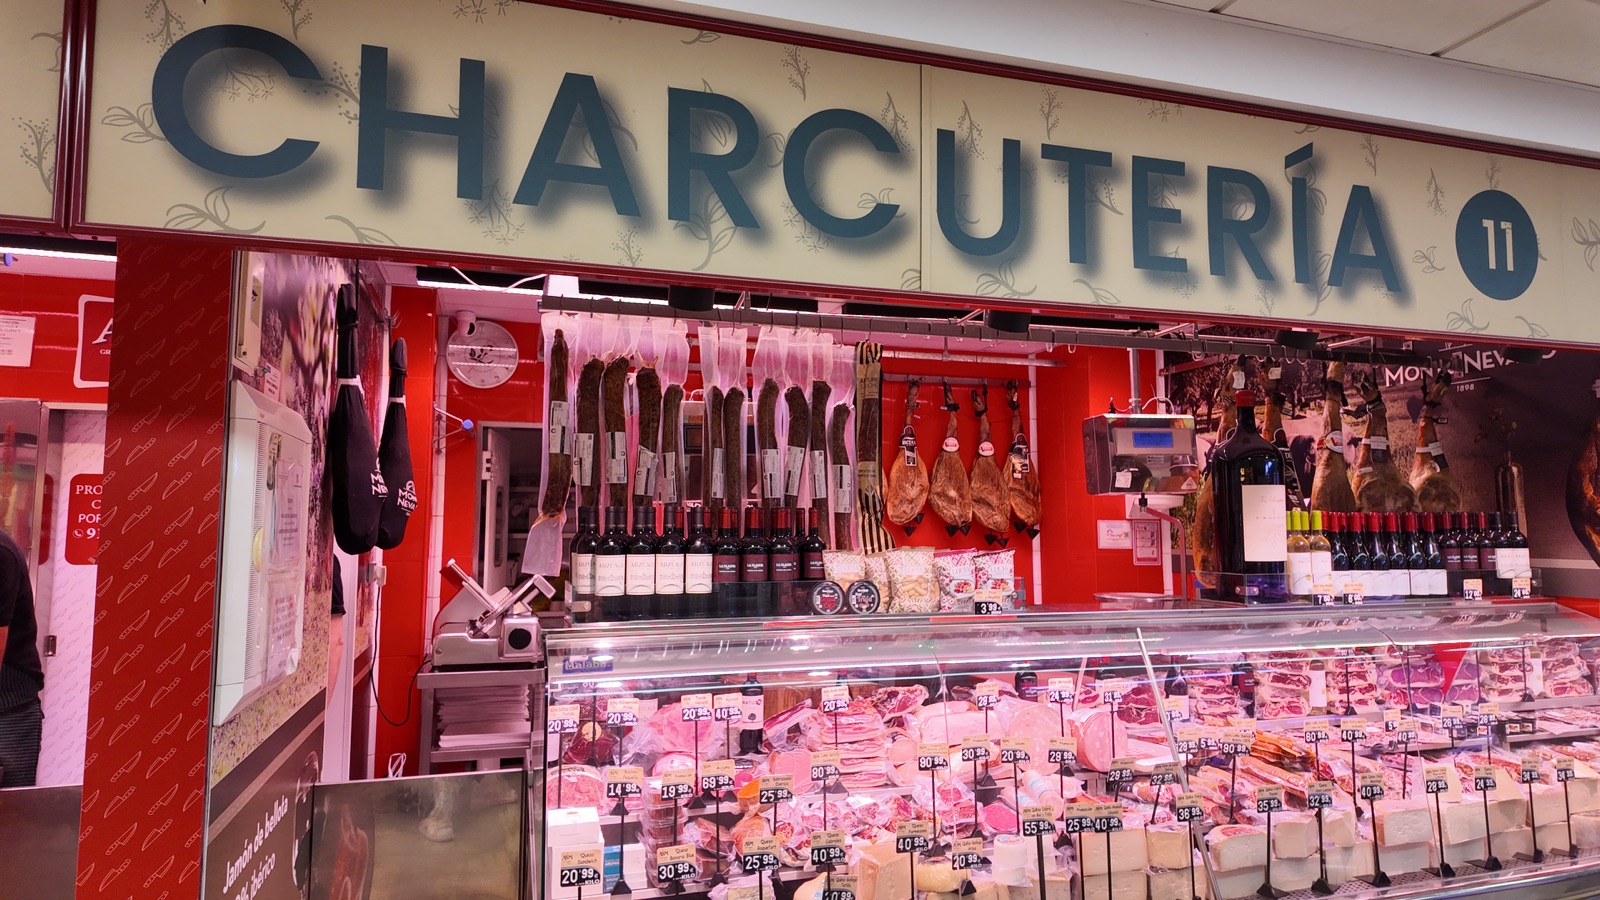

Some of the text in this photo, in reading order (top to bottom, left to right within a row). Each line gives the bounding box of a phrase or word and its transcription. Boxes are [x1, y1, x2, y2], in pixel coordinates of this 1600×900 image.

[152, 25, 1515, 291] CHARCUTERÍA 11
[1456, 384, 1475, 392] 1898
[222, 795, 289, 894] Jamón de bellota
